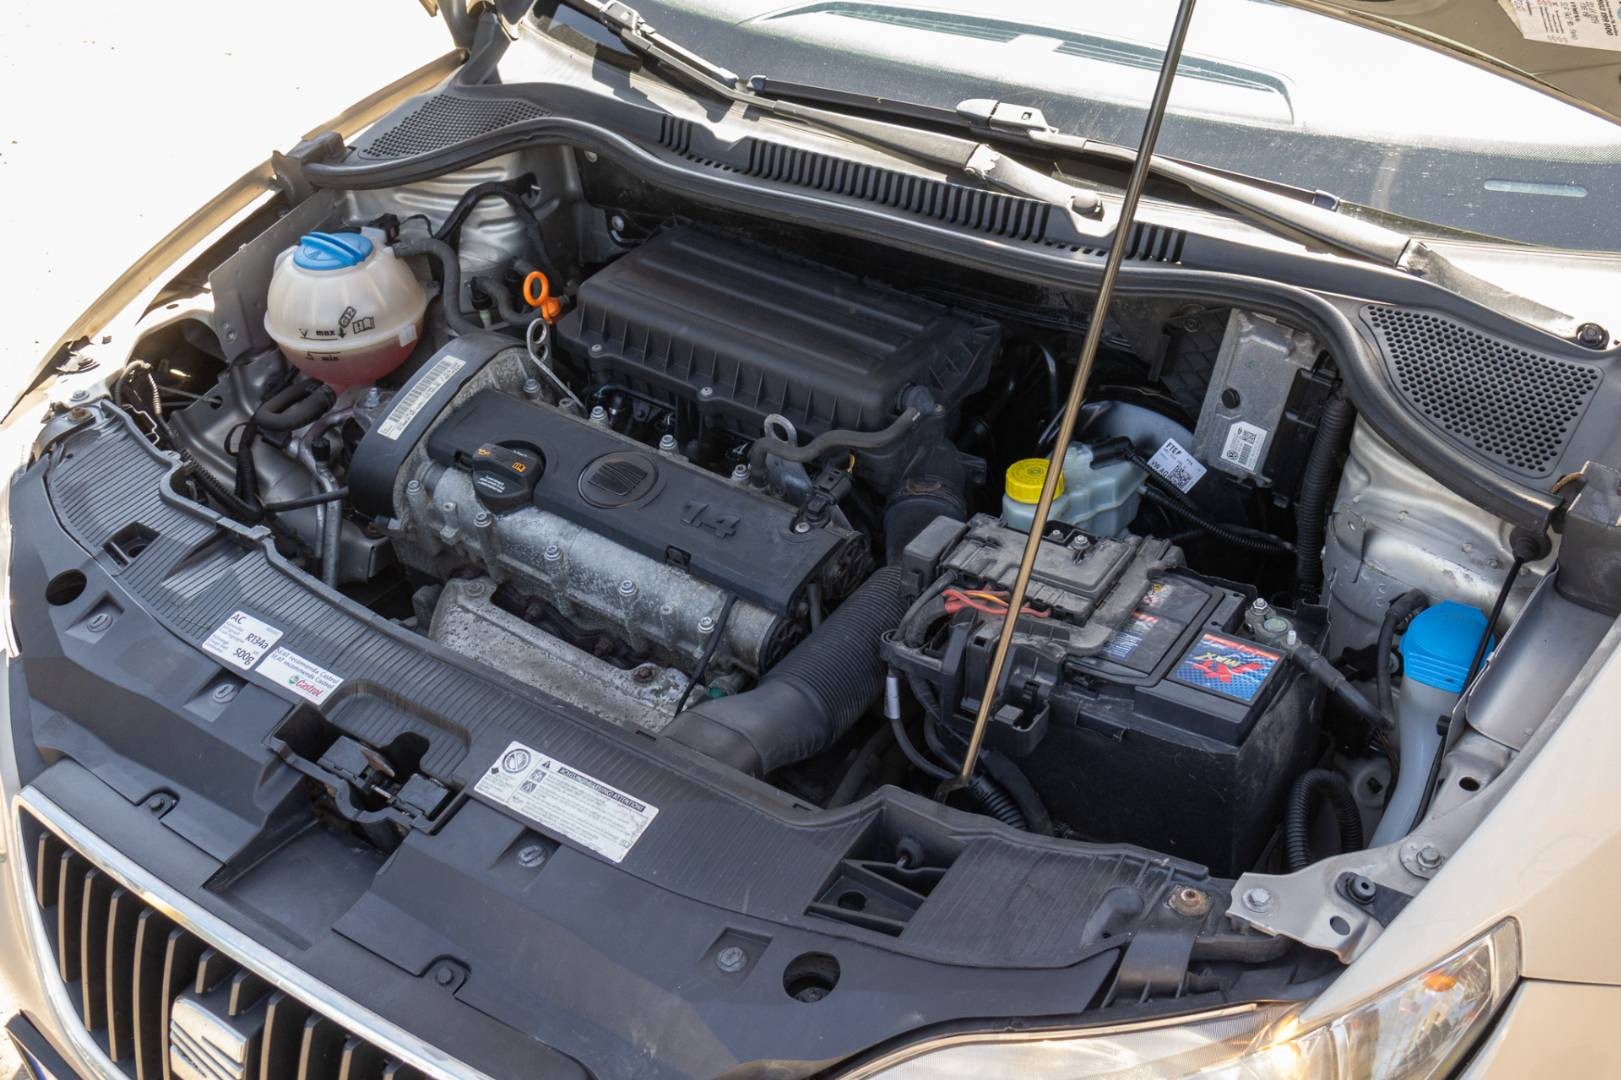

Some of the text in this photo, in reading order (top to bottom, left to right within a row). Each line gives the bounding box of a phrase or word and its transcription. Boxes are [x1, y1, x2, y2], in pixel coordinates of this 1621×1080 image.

[230, 613, 246, 624] AC
[246, 632, 270, 649] R134a
[232, 647, 255, 665] 500g
[295, 678, 323, 697] Castrol
